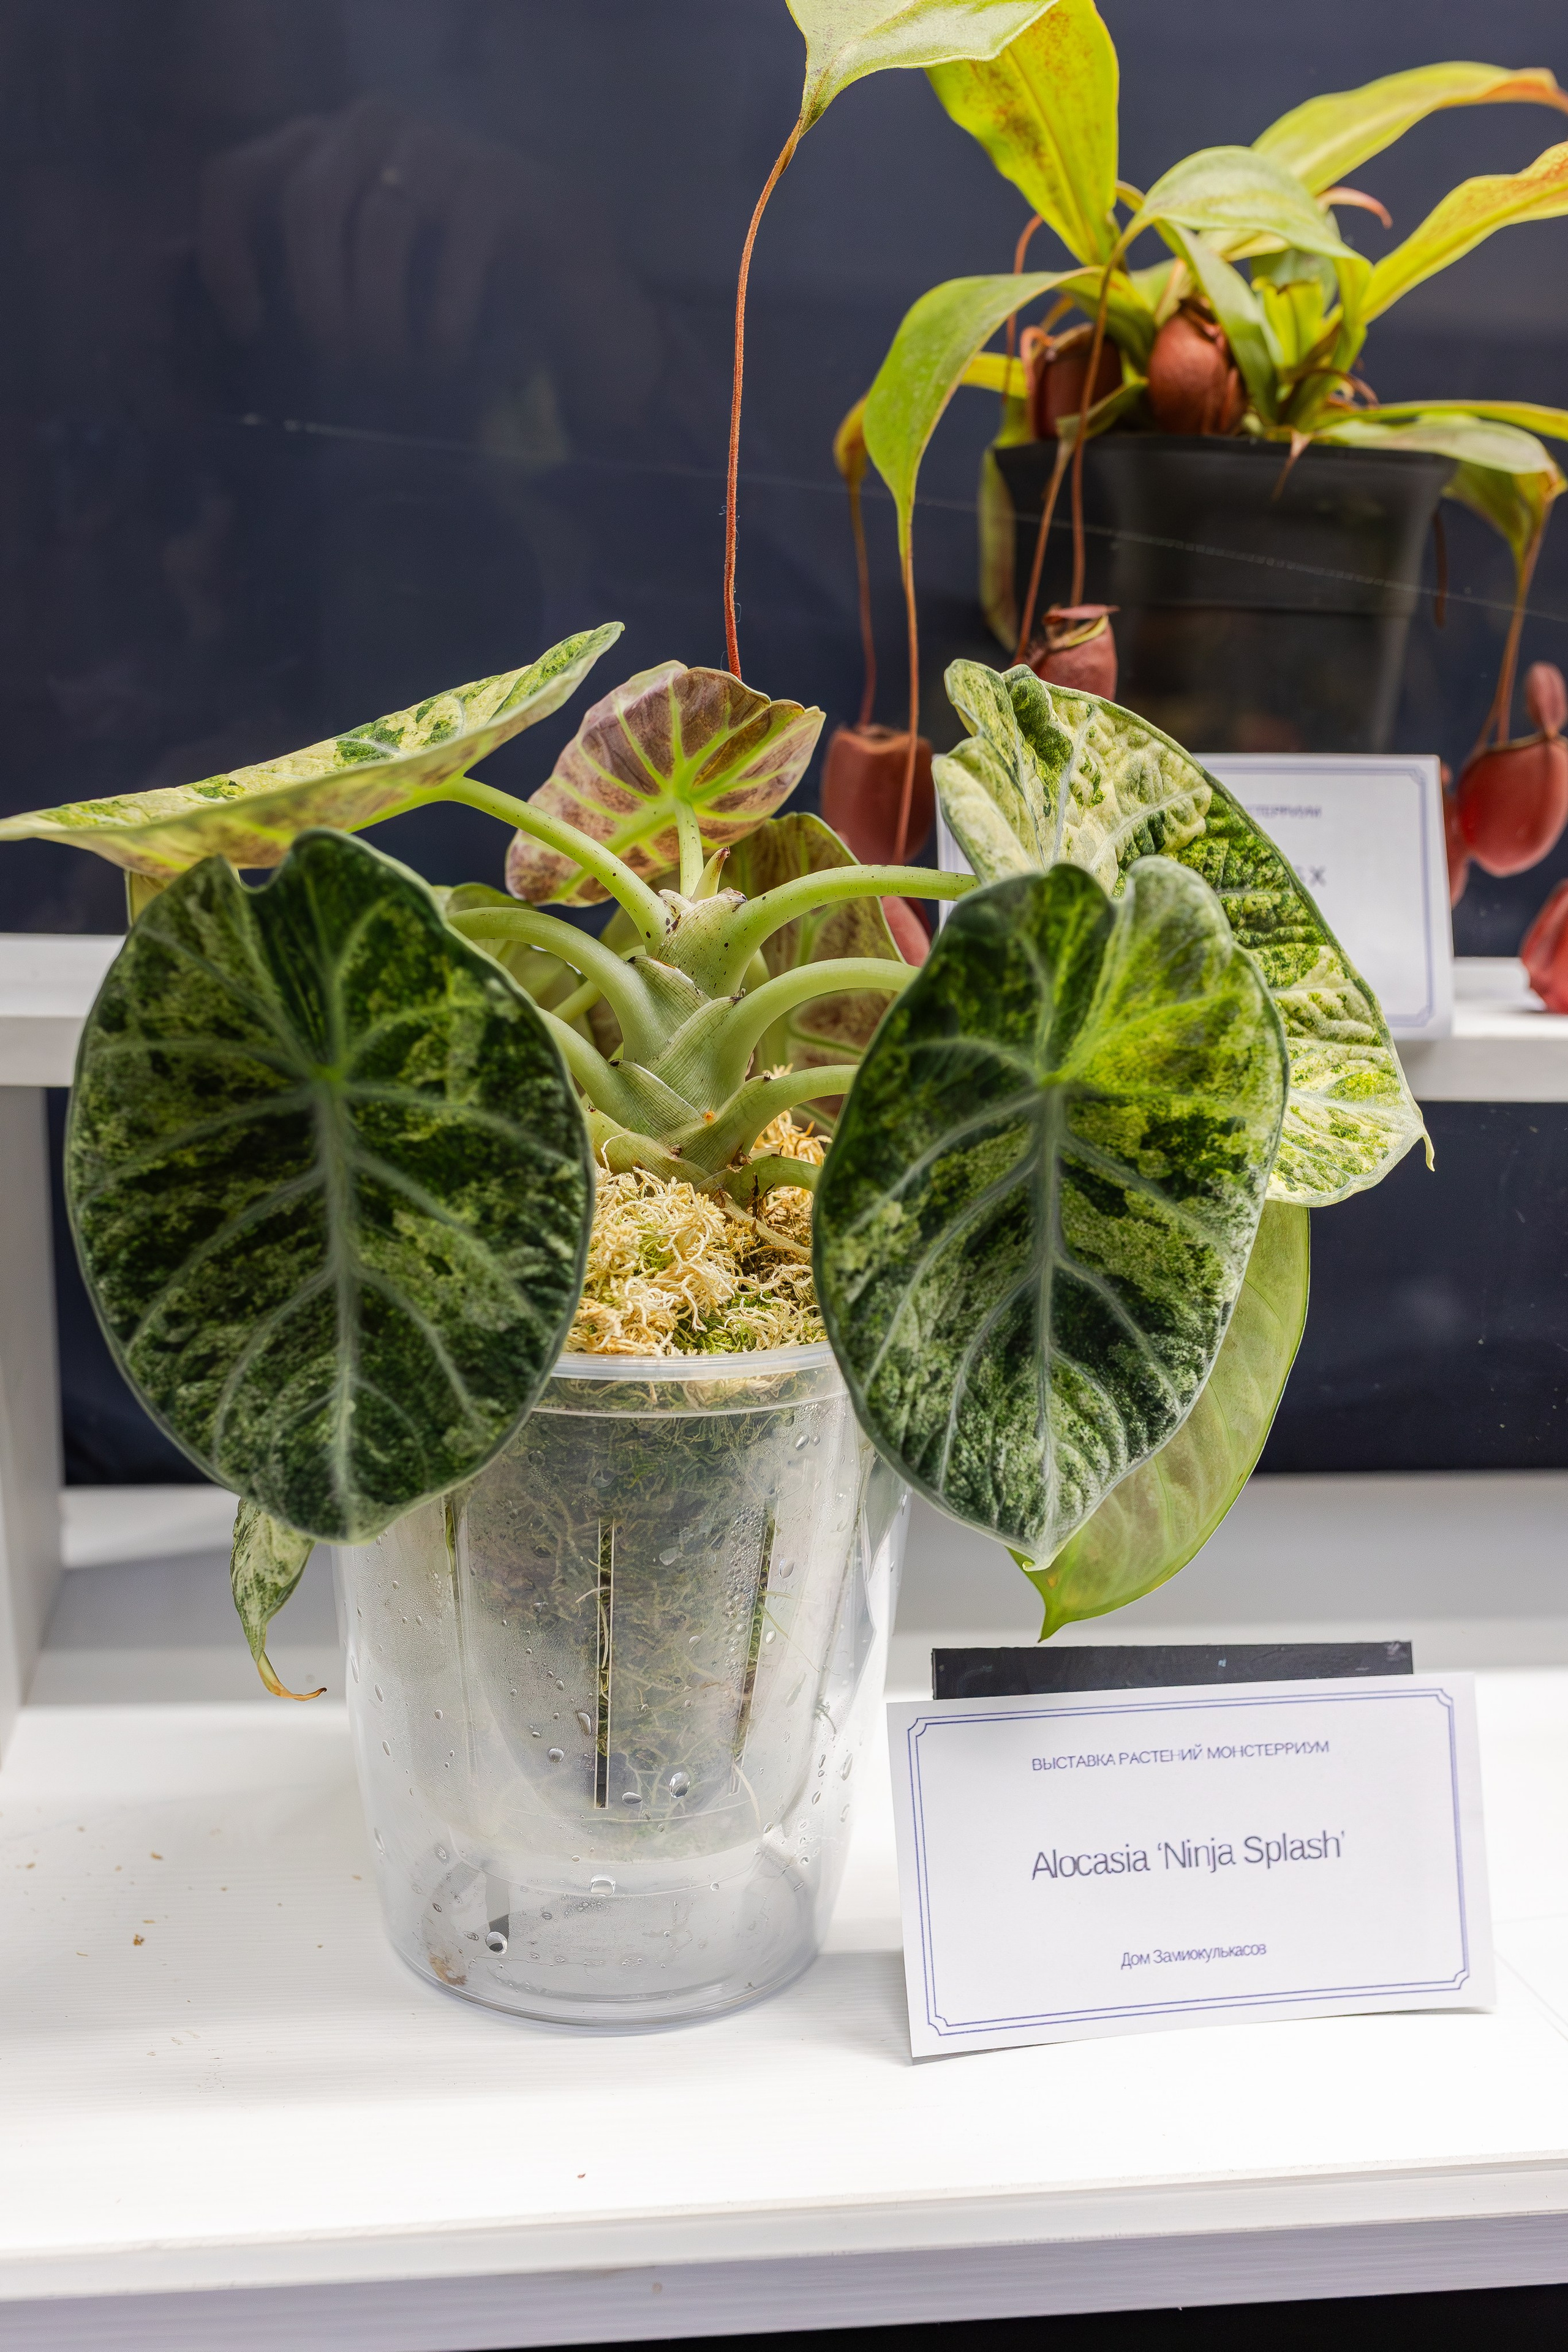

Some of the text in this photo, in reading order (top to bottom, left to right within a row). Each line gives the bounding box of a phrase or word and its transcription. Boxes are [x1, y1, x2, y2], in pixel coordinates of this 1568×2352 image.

[1031, 1740, 1330, 1771] ВЫСТАВКА РАСТЕНИЙ МОНСТЕРРИУМ
[1031, 1844, 1151, 1880] Alocasia
[1120, 1943, 1267, 1970] Дом Замиокулькасов
